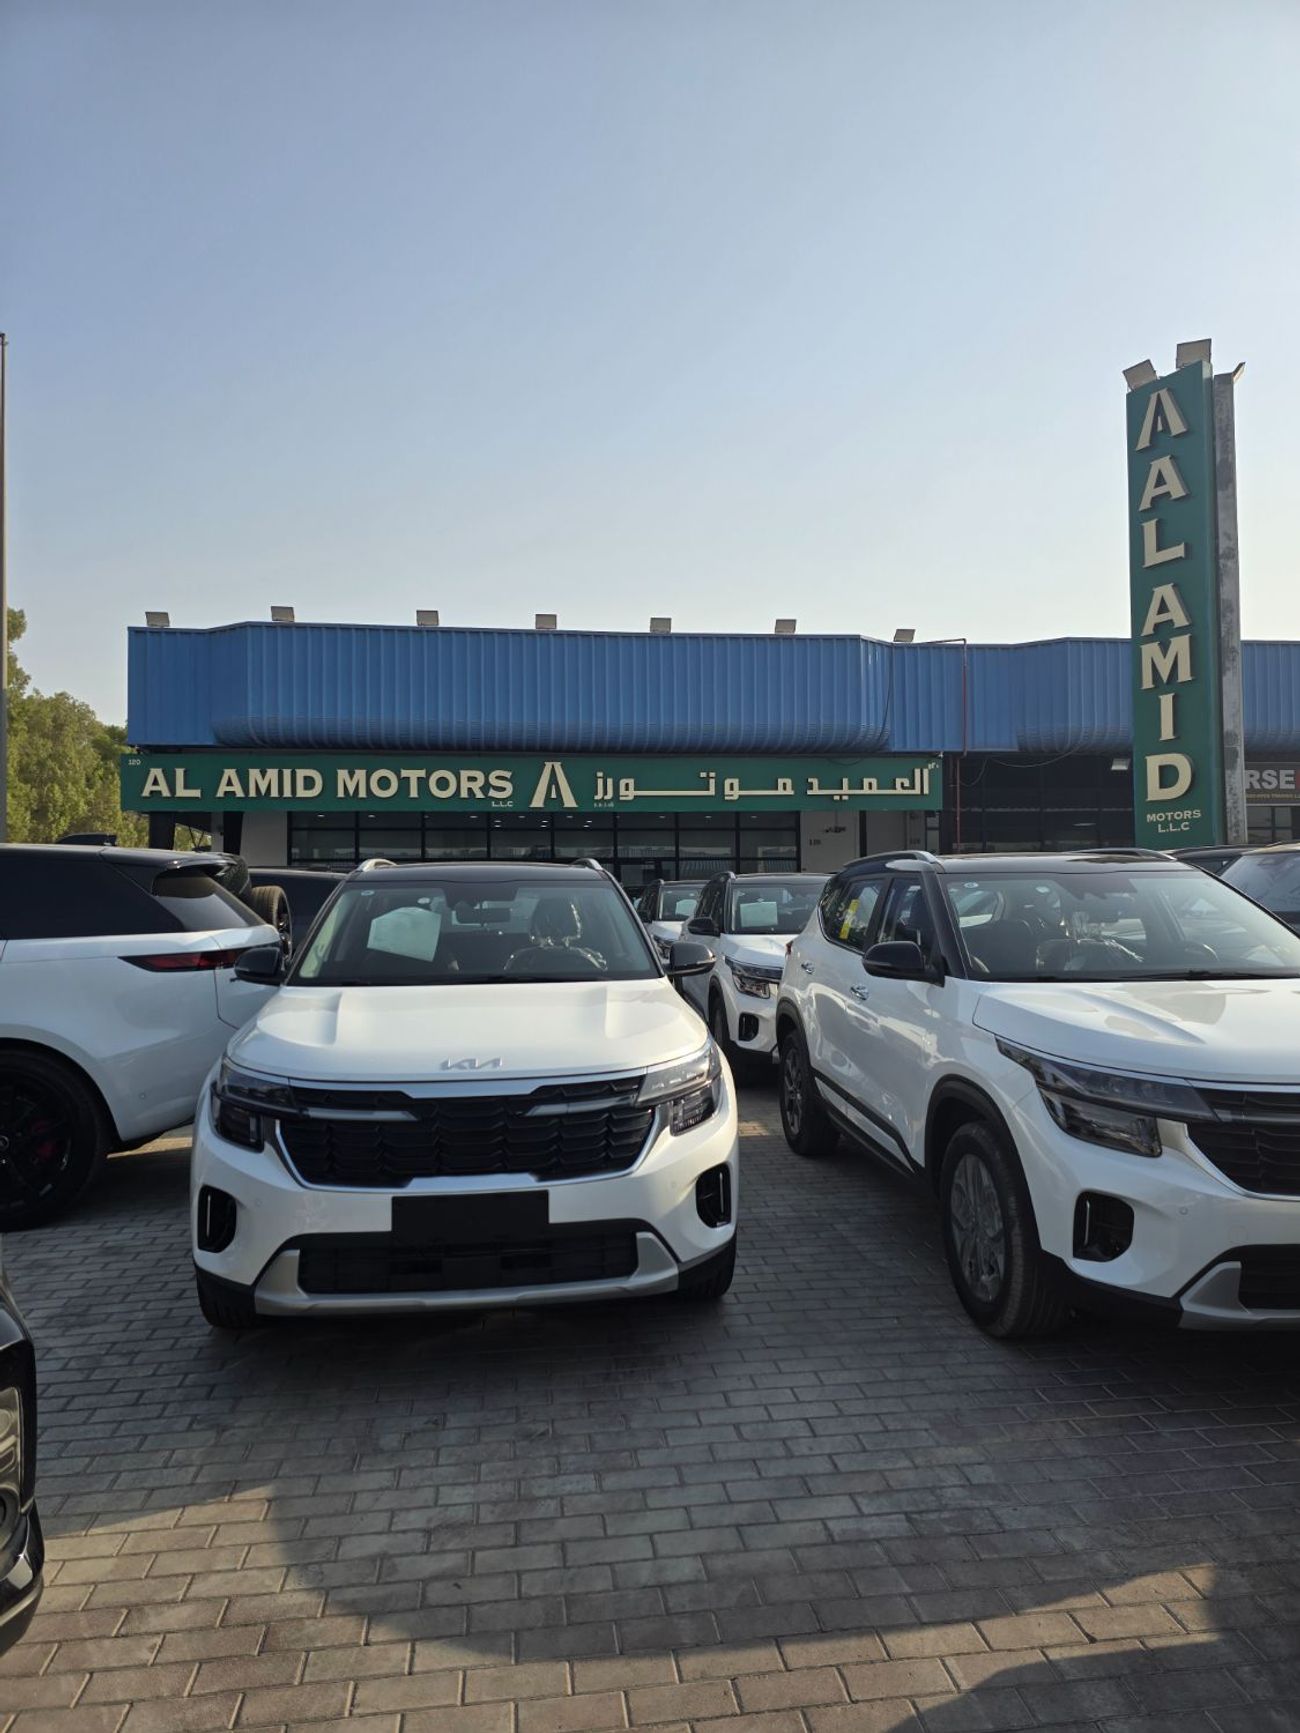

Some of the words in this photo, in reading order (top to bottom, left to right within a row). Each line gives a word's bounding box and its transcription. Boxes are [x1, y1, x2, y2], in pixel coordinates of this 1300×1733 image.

[1139, 456, 1187, 568] AL
[1140, 583, 1194, 802] AMID
[141, 768, 202, 798] AL
[215, 768, 323, 798] AMID
[336, 769, 514, 799] MOTORS
[593, 771, 795, 801] موتورز
[806, 767, 930, 801] العميد
[1244, 769, 1296, 790] RSE
[1146, 810, 1201, 824] MOTORS
[1157, 821, 1190, 833] L.L.C
